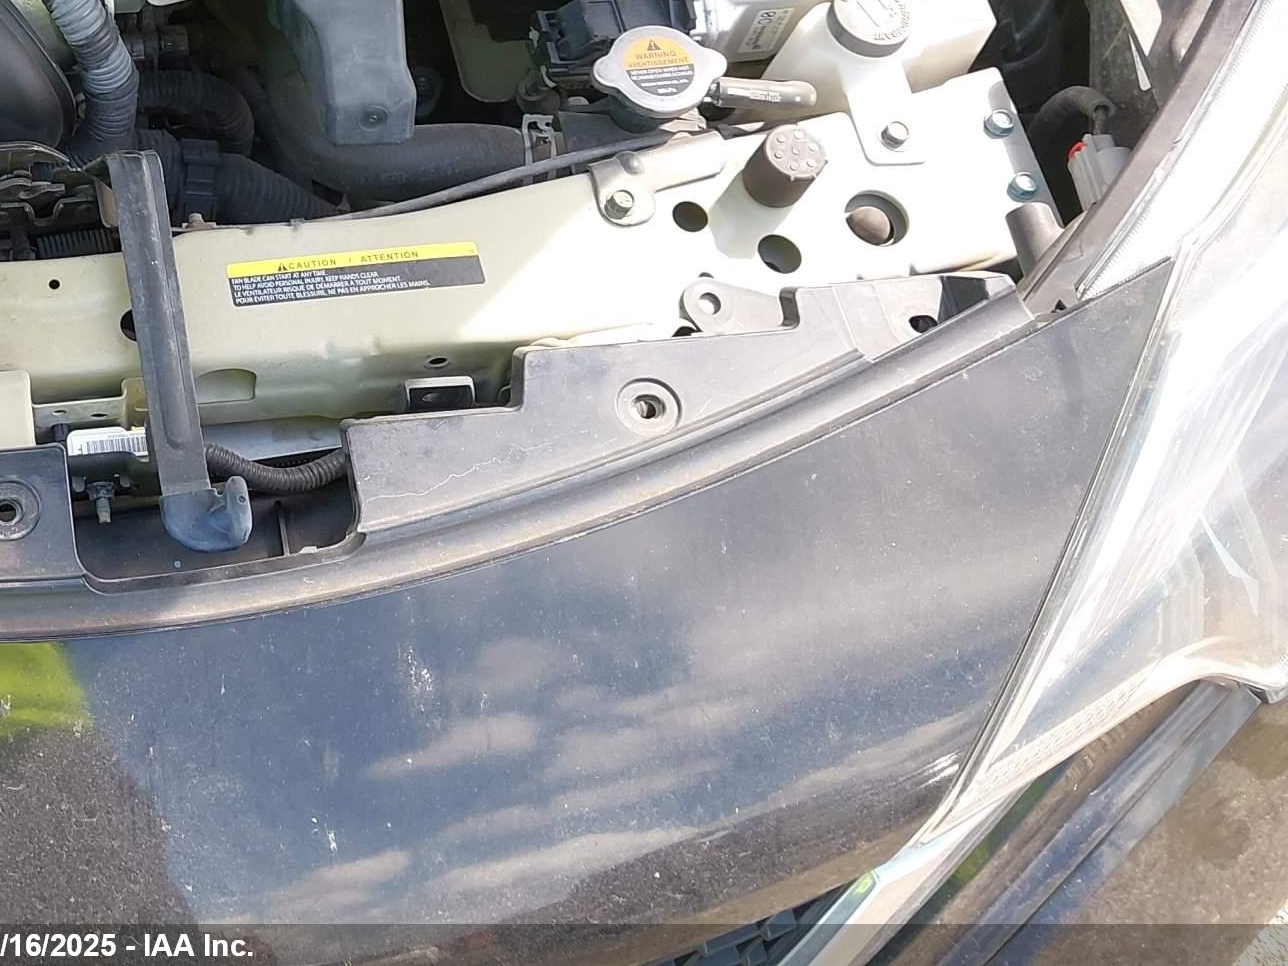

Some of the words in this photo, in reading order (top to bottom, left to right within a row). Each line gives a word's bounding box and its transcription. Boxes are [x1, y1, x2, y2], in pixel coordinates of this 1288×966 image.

[636, 50, 677, 60] WARNING
[288, 258, 336, 270] CAUTION
[361, 251, 418, 263] ATTENTION
[275, 279, 304, 288] PERSONAL
[339, 273, 359, 281] HANDS
[242, 287, 283, 296] VENTILATEUR
[283, 284, 305, 293] RISQUE
[360, 282, 396, 292] APPROCHER
